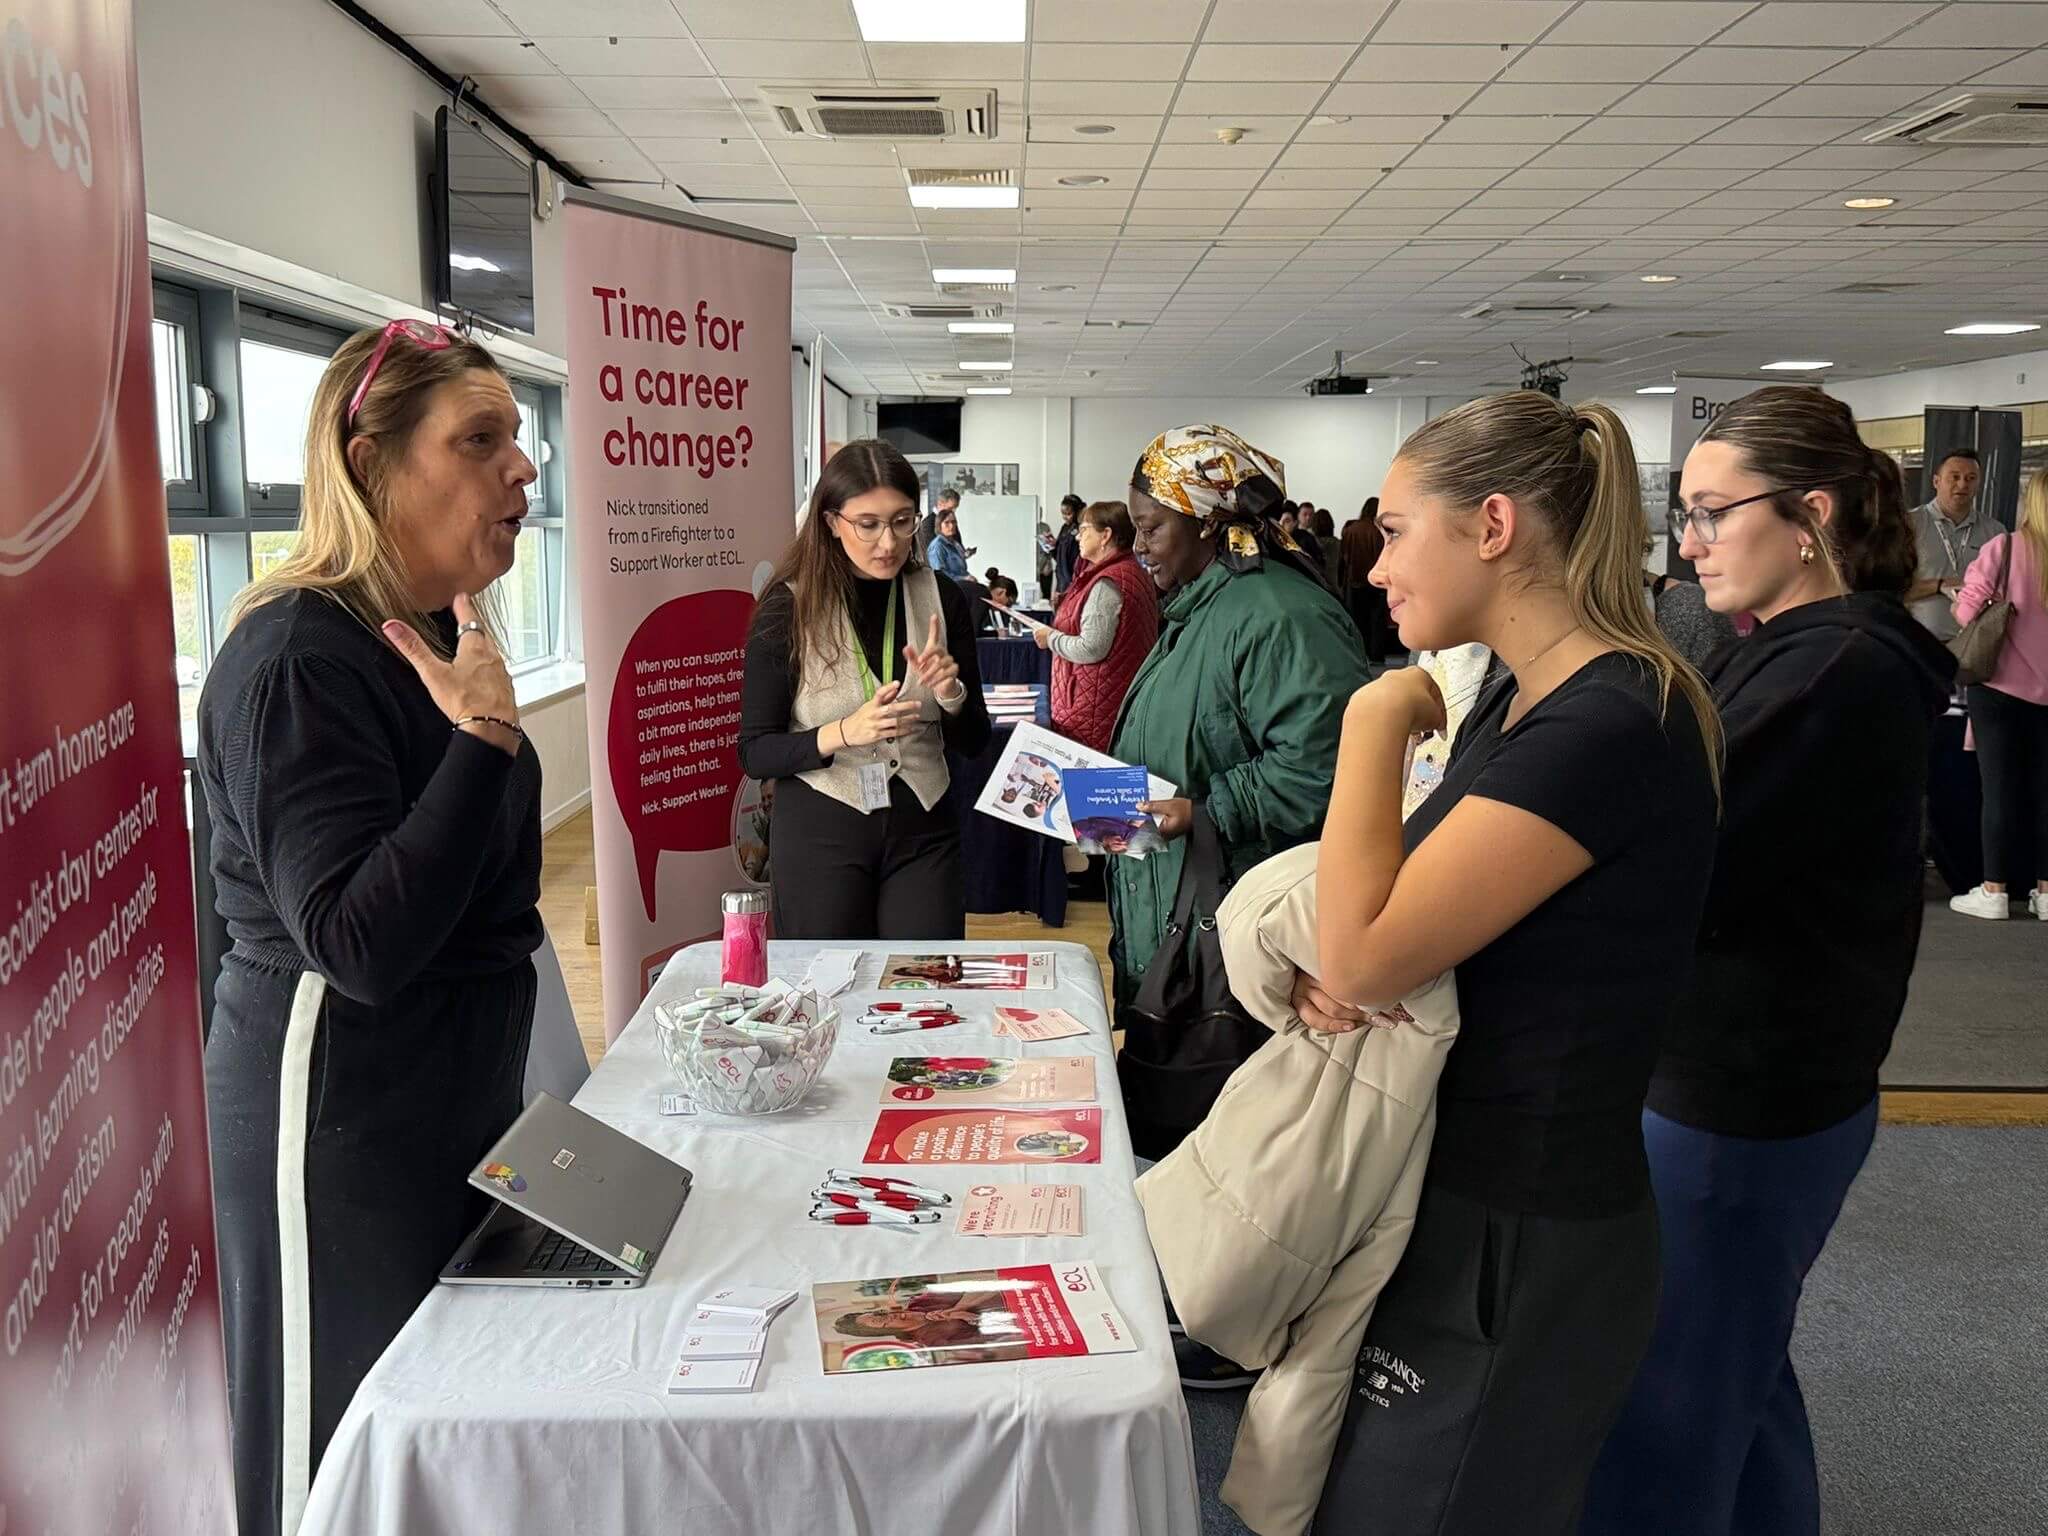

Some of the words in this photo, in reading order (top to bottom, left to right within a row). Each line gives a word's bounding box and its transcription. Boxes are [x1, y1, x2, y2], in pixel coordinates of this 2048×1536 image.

[0, 17, 92, 188] ces
[593, 287, 687, 346] Time
[695, 301, 744, 352] for
[600, 365, 623, 402] a
[635, 368, 748, 410] career
[604, 417, 753, 479] change?
[607, 500, 636, 516] Nick
[638, 499, 709, 516] transitioned
[608, 527, 639, 545] from
[641, 531, 650, 545] a
[651, 526, 711, 544] Firefighter
[713, 527, 725, 541] to
[727, 528, 735, 540] a
[610, 556, 658, 575] Support
[660, 553, 703, 571] Worker
[706, 553, 719, 567] at
[720, 550, 745, 566] ECL.
[635, 659, 660, 674] When
[662, 658, 681, 673] you
[682, 655, 702, 667] can
[704, 648, 738, 665] support
[636, 685, 646, 697] to
[647, 678, 667, 695] fulfil
[669, 675, 694, 691] their
[696, 673, 726, 687] hopes,
[637, 699, 693, 720] aspirations,
[694, 693, 715, 708] help
[717, 690, 740, 704] them
[55, 725, 107, 782] home
[109, 701, 135, 750] care
[638, 731, 645, 742] a
[646, 726, 659, 740] bit
[660, 723, 686, 737] more
[640, 747, 661, 765] daily
[663, 745, 688, 759] lives,
[689, 739, 716, 753] there
[717, 735, 725, 746] is
[725, 732, 740, 748] jus
[640, 770, 671, 787] feeling
[672, 764, 697, 778] than
[698, 758, 721, 773] that.
[641, 801, 661, 815] Nick,
[662, 790, 698, 809] Support
[699, 784, 730, 800] Worker.
[57, 849, 91, 912] day
[95, 804, 142, 879] centres
[141, 781, 158, 830] for
[0, 1024, 31, 1115] der
[34, 947, 85, 1071] people
[87, 903, 120, 980] and
[121, 863, 157, 956] people
[35, 1038, 99, 1172] learning
[101, 942, 164, 1062] disabilities
[912, 1131, 929, 1151] make
[931, 1127, 949, 1154] positive
[946, 1126, 967, 1160] difference
[970, 1123, 986, 1152] people's
[985, 1136, 1004, 1160] quality
[908, 1151, 923, 1160] To
[966, 1152, 980, 1160] to
[81, 1256, 103, 1331] for
[106, 1166, 152, 1292] people
[152, 1111, 174, 1187] with
[962, 1211, 980, 1232] We're
[983, 1196, 1003, 1230] recruiting
[5, 1207, 61, 1356] and/or
[62, 1114, 116, 1232] autism
[167, 1244, 201, 1359] speech
[1372, 1347, 1421, 1393] BALANCE
